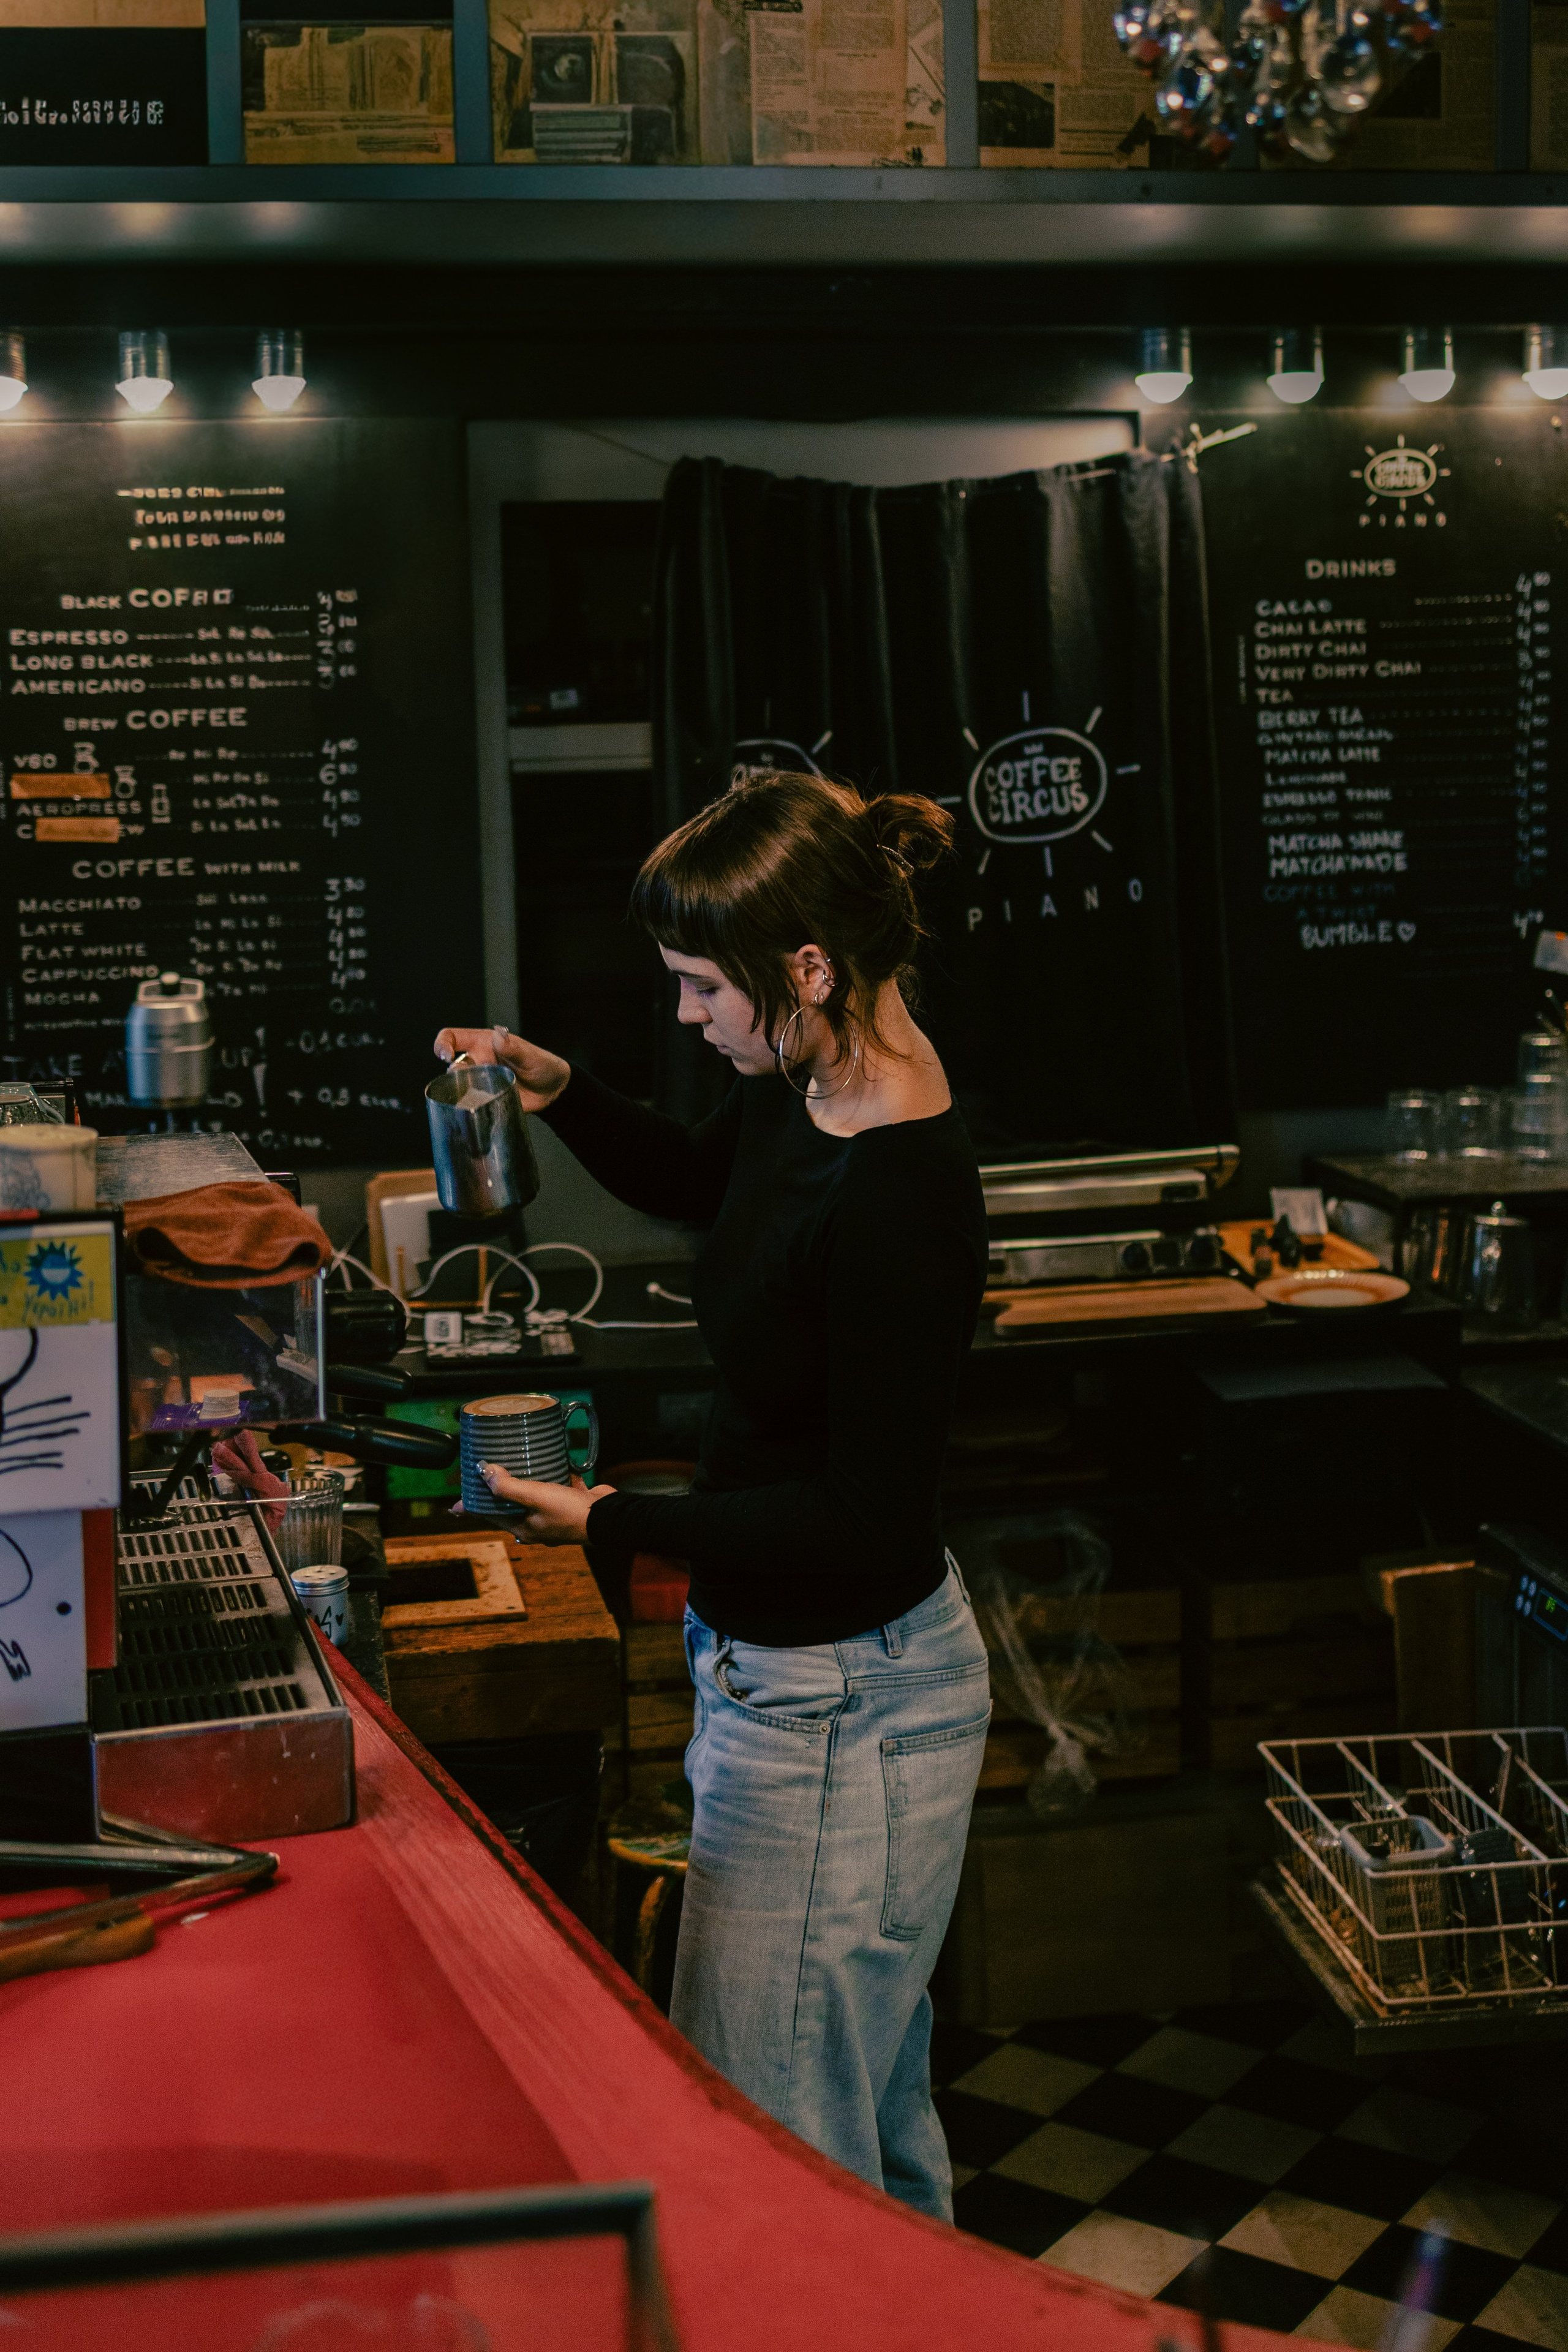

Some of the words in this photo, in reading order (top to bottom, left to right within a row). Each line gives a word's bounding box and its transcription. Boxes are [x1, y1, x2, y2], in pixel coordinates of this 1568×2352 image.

[1358, 511, 1447, 529] PIANO
[1305, 559, 1395, 579] DRINKS
[61, 595, 121, 609] BLACK
[10, 629, 128, 646] ESPRESSO
[1254, 621, 1303, 638] CHAI
[1309, 619, 1365, 635] LATTE
[1254, 643, 1313, 660] DIRTY
[1318, 640, 1366, 657] CHAI
[10, 654, 74, 671] LONG
[81, 654, 152, 669] BLACK
[12, 679, 146, 694] AMERICANO
[1256, 688, 1292, 703] TEA
[64, 718, 117, 731] BREW
[126, 707, 246, 729] COFFEE
[982, 755, 1084, 795] COFFEE
[17, 800, 141, 817] AEROPRESS
[1268, 834, 1343, 854] MATCHA
[72, 858, 194, 879] COFFEE
[205, 862, 251, 874] WITH
[258, 861, 300, 872] MILK
[18, 897, 141, 913] MACCHIATO
[965, 877, 1144, 932] PIANO
[20, 922, 83, 937] LATTE
[1300, 921, 1392, 949] BUMBLE
[21, 945, 74, 960] FLAT
[81, 943, 146, 956] WHITE
[22, 965, 160, 984] CAPPUCCINO
[24, 992, 100, 1005] MOCHA
[1, 1052, 83, 1082] TAKE
